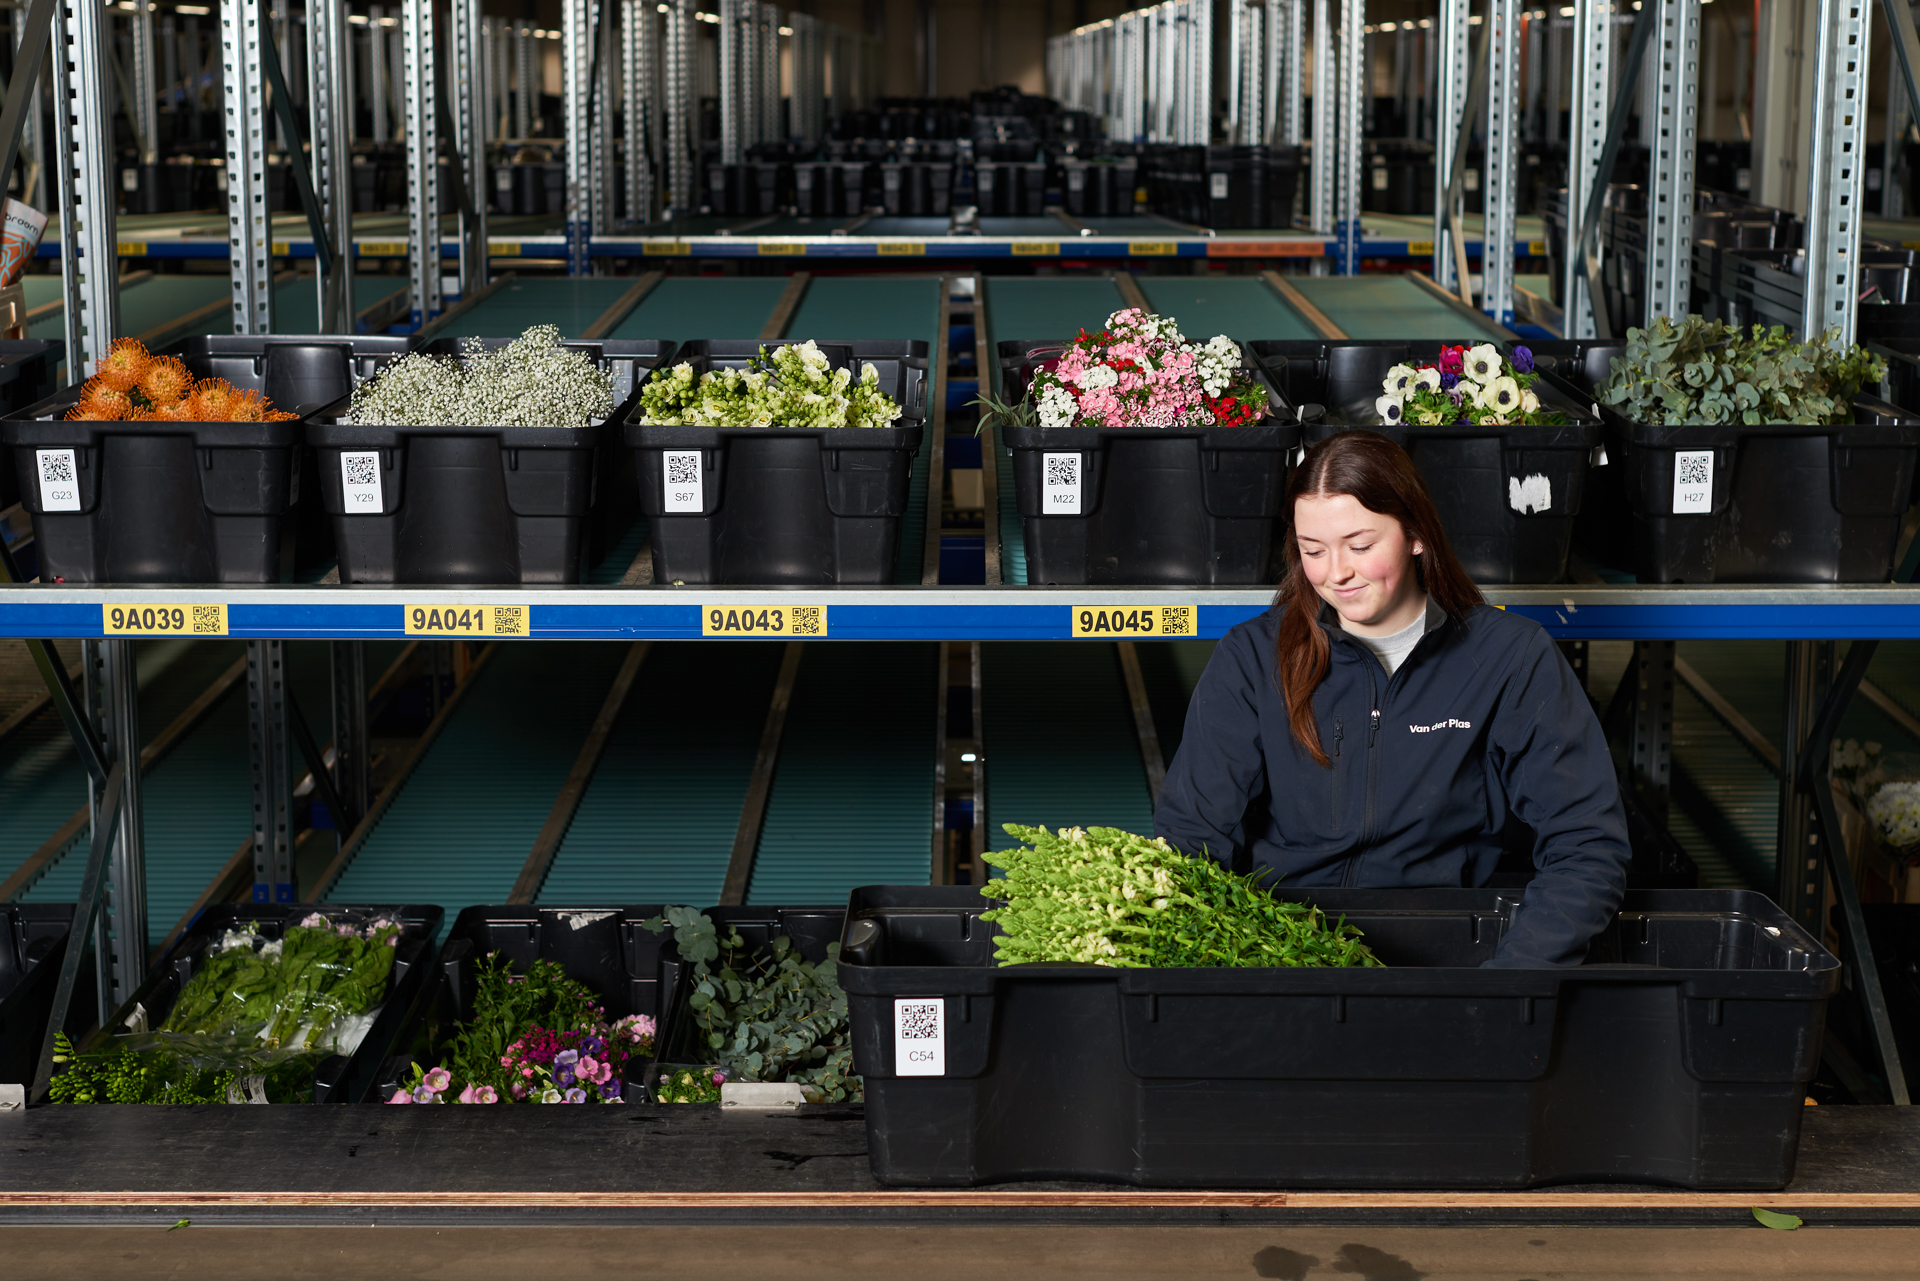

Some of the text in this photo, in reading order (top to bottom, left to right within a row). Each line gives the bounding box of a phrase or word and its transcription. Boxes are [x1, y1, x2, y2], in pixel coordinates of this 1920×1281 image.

[51, 490, 74, 501] G23
[353, 493, 375, 503] Y29
[675, 492, 696, 502] S67
[1053, 494, 1075, 504] M22
[1684, 492, 1705, 502] H27
[110, 608, 185, 631] 9A039
[412, 608, 485, 631] 9A041
[709, 609, 784, 632] 9A043
[1079, 610, 1154, 633] 9A045
[1409, 718, 1471, 733] Van der Plas
[909, 1050, 935, 1062] C54
